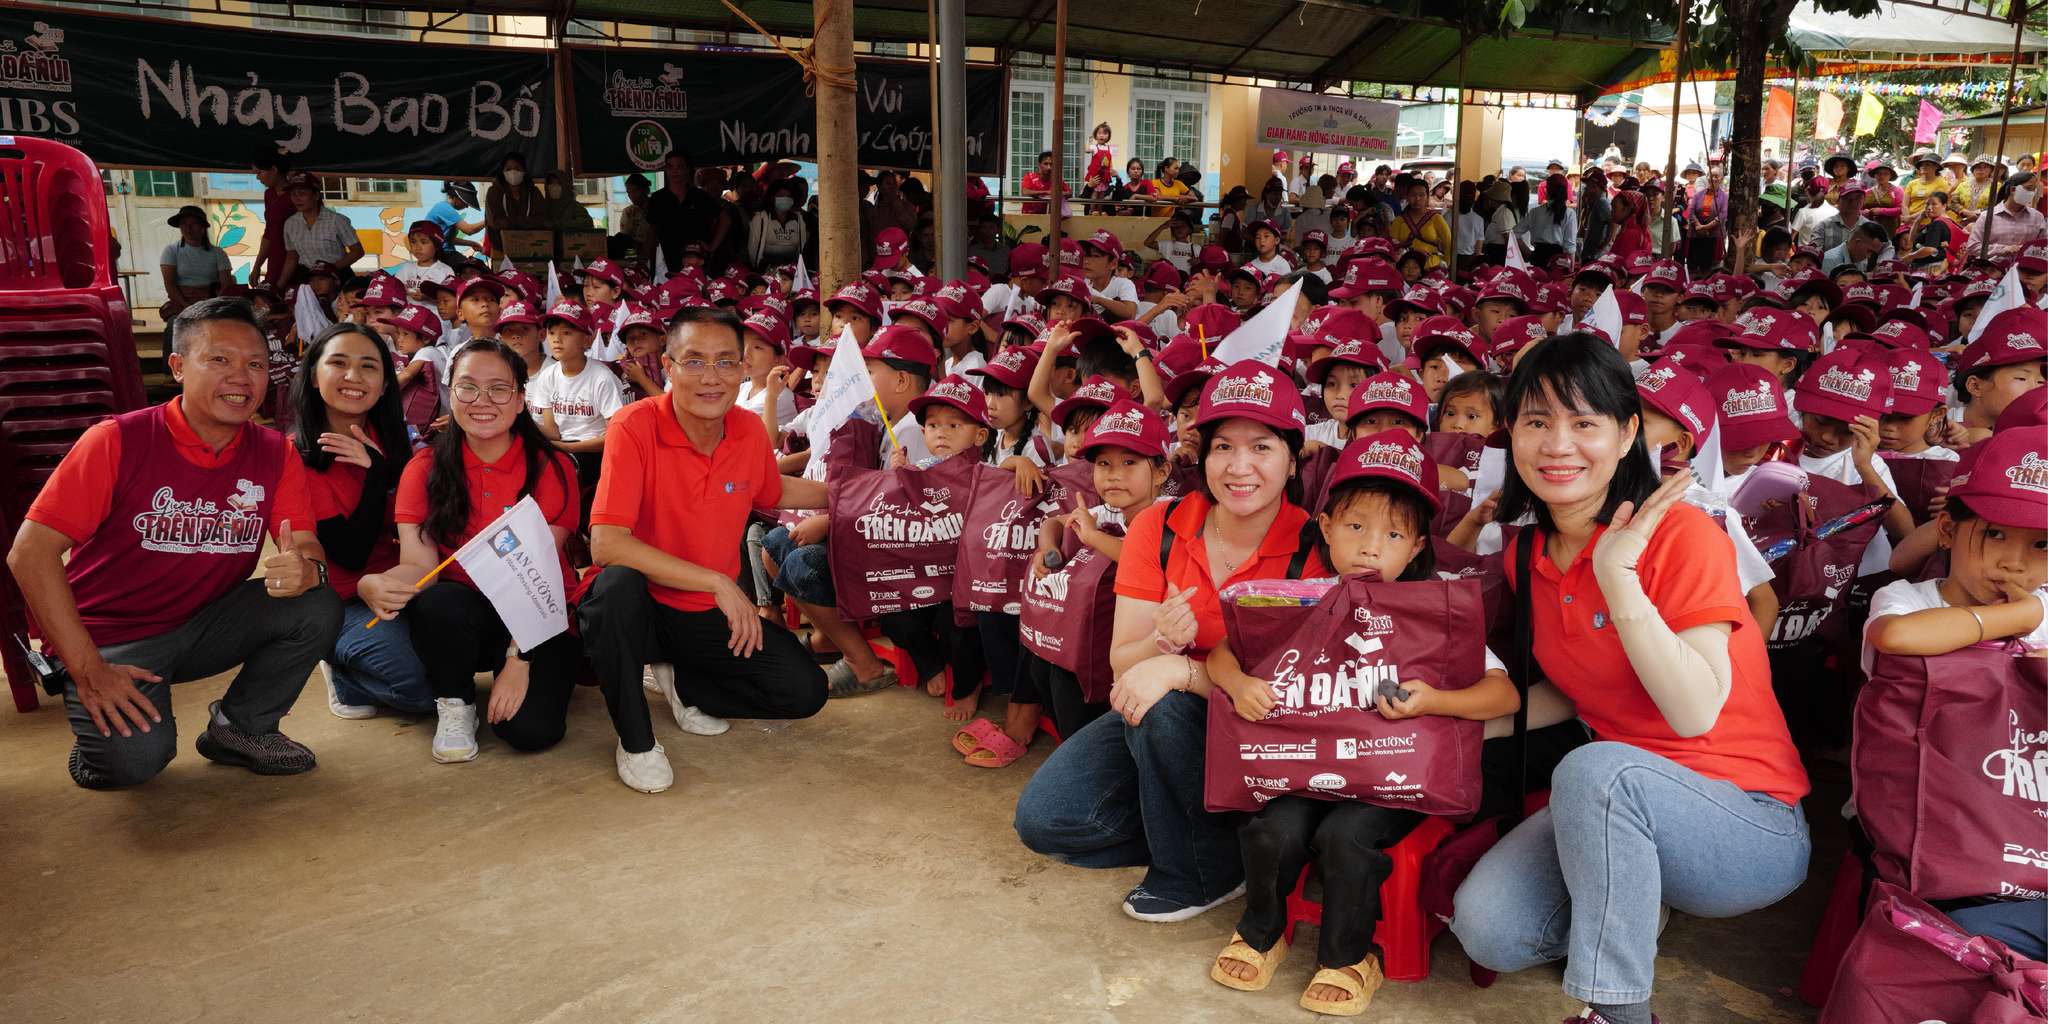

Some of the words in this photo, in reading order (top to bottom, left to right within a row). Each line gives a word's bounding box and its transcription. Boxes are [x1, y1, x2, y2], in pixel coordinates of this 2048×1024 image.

[138, 57, 312, 153] Nhảy
[333, 71, 449, 137] Bao
[470, 80, 542, 140] Bố
[863, 78, 903, 113] Vui
[719, 119, 809, 156] Nhanh
[1266, 127, 1285, 139] GIAN
[869, 492, 900, 516] Gieo
[856, 513, 906, 541] TRÊN
[1367, 620, 1393, 631] 2030
[1310, 664, 1352, 707] ĐÁ
[1239, 744, 1317, 753] PACIFIC
[1357, 739, 1373, 749] AN
[1374, 736, 1413, 749] CƯỜNG
